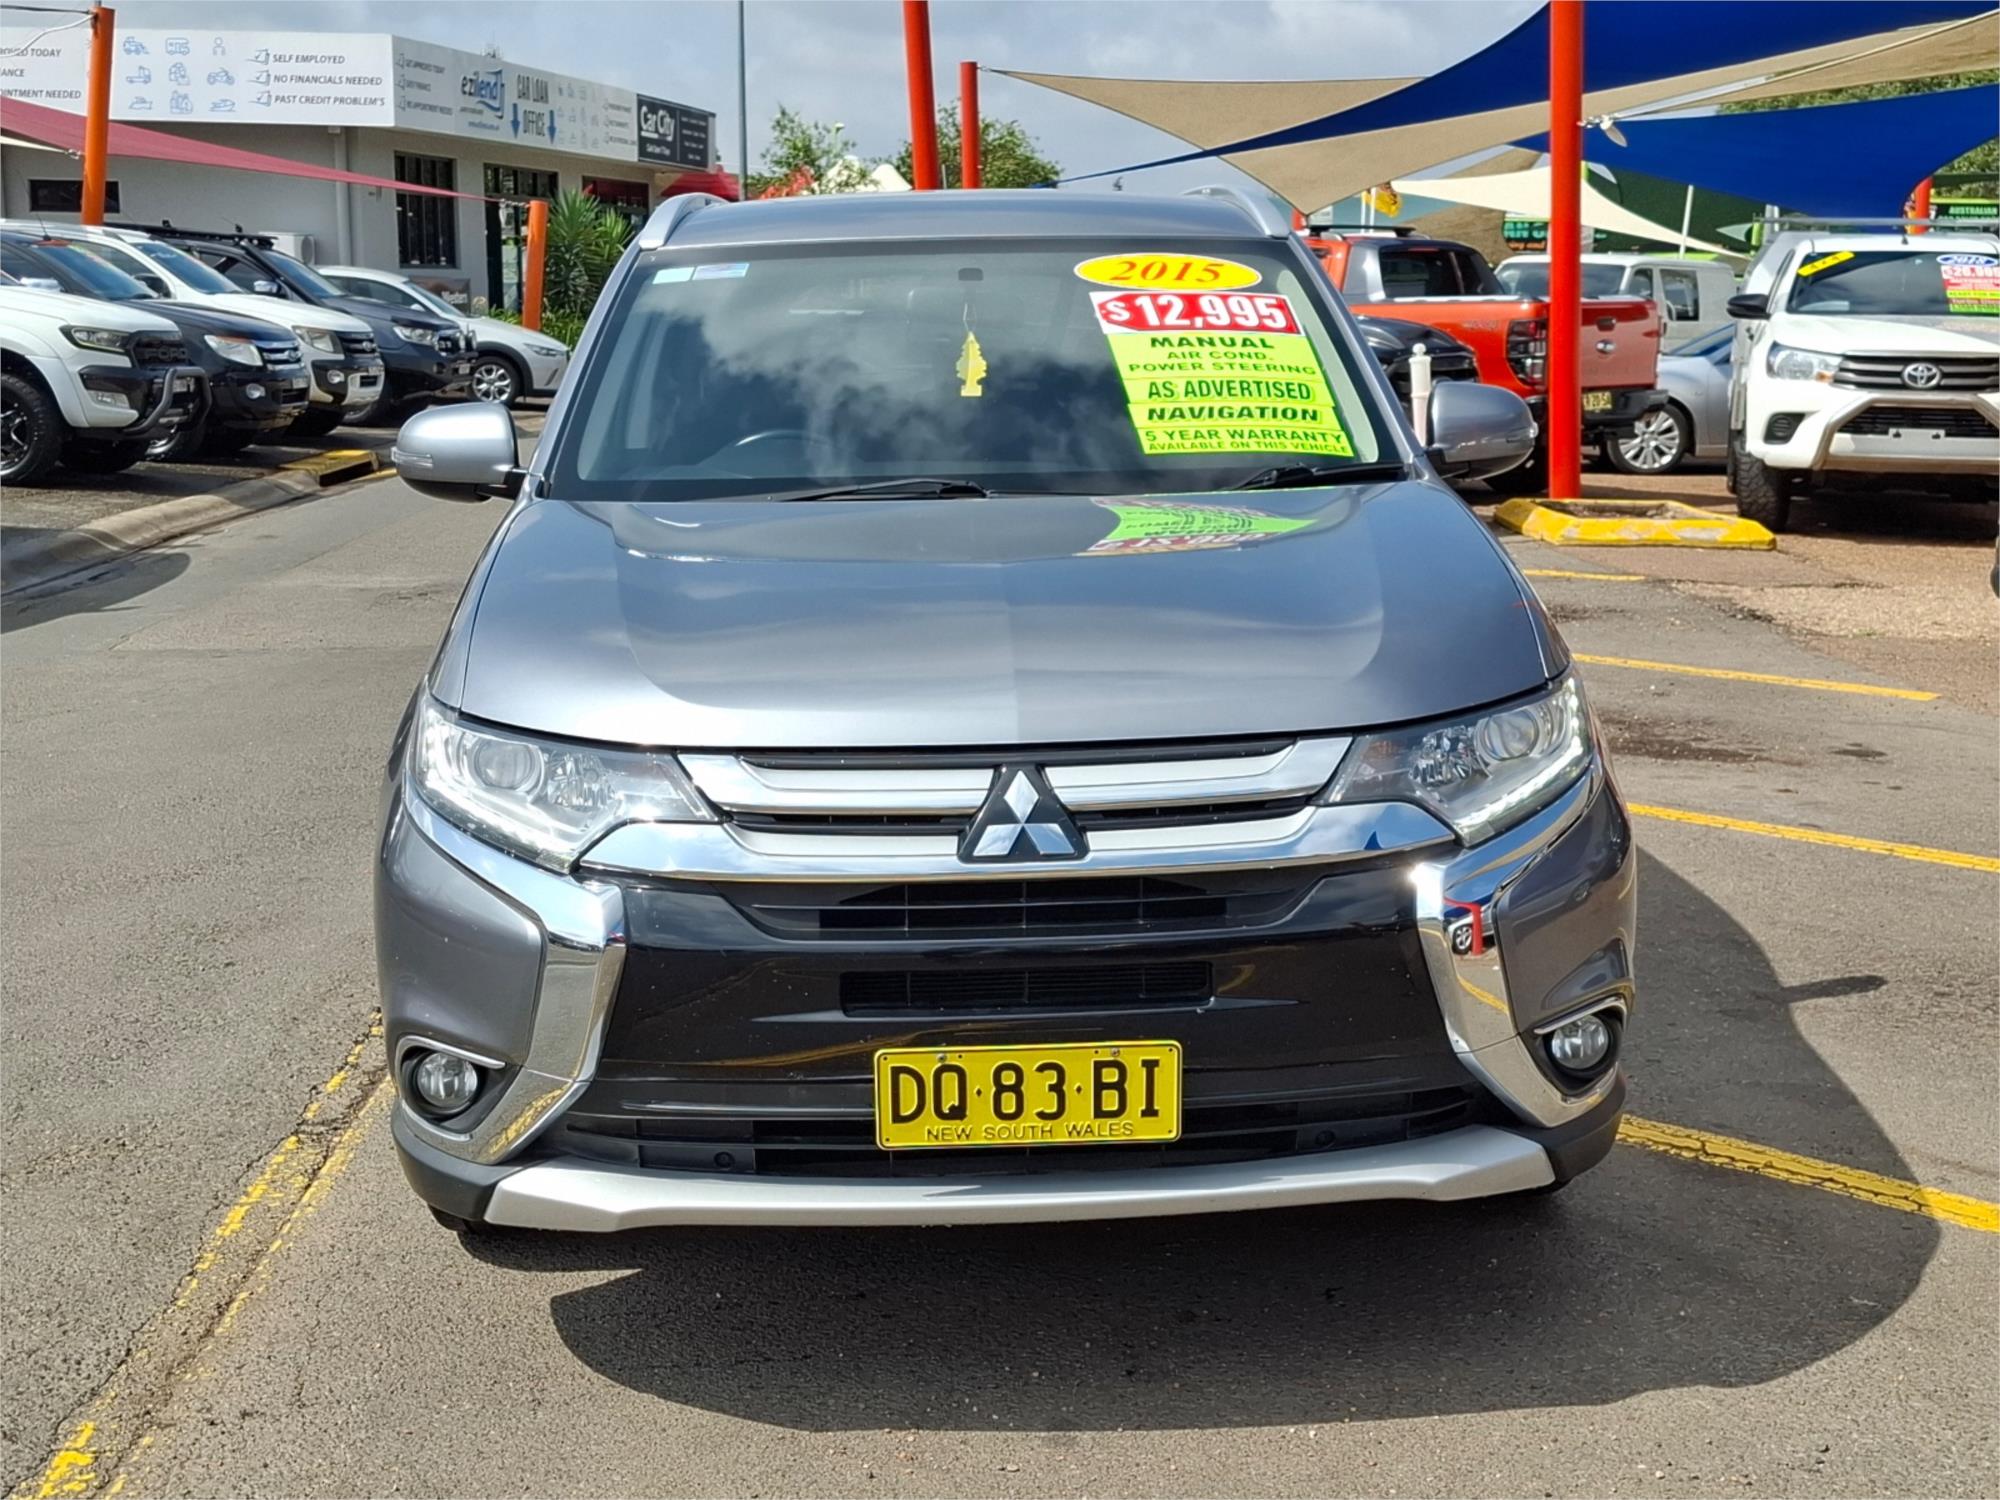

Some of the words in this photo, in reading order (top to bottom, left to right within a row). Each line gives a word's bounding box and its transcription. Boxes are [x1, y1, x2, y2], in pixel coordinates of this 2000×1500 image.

[30, 48, 61, 57] TODAY
[272, 54, 293, 63] SELF
[295, 55, 345, 64] EMPLOYED
[0, 68, 24, 77] ANCE
[273, 74, 288, 83] NO
[290, 75, 343, 85] FINANCIALS
[345, 76, 382, 86] NEEDED
[45, 90, 81, 99] NEEDED
[517, 74, 530, 100] CAR
[532, 77, 550, 104] LOAN
[274, 95, 296, 104] PAST
[298, 95, 331, 105] CREDIT
[333, 97, 385, 106] PROBLEM'S
[523, 109, 545, 137] OFFICE
[1949, 206, 1998, 215] AUSTRALIAN
[1111, 260, 1224, 283] 2015
[1104, 294, 1287, 329] $12,995
[1150, 336, 1275, 349] MANUAL
[1167, 351, 1201, 360] AIR
[1209, 351, 1274, 361] COND.
[1128, 362, 1205, 372] POWER
[1211, 362, 1316, 375] STEERING
[1148, 381, 1175, 399] AS
[1184, 379, 1311, 400] ADVERTISED
[1148, 406, 1319, 421] NAVIGATION
[1145, 430, 1157, 442] 5
[1163, 429, 1221, 441] YEAR
[1226, 429, 1342, 444] WARRANTY
[1148, 442, 1225, 451] AVAILABLE
[1230, 441, 1250, 450] ON
[1253, 440, 1287, 449] THIS
[1290, 442, 1347, 453] VEHICLE
[925, 1126, 972, 1141] NEW
[983, 1123, 1053, 1139] SOUTH
[1065, 1120, 1134, 1137] WALES
